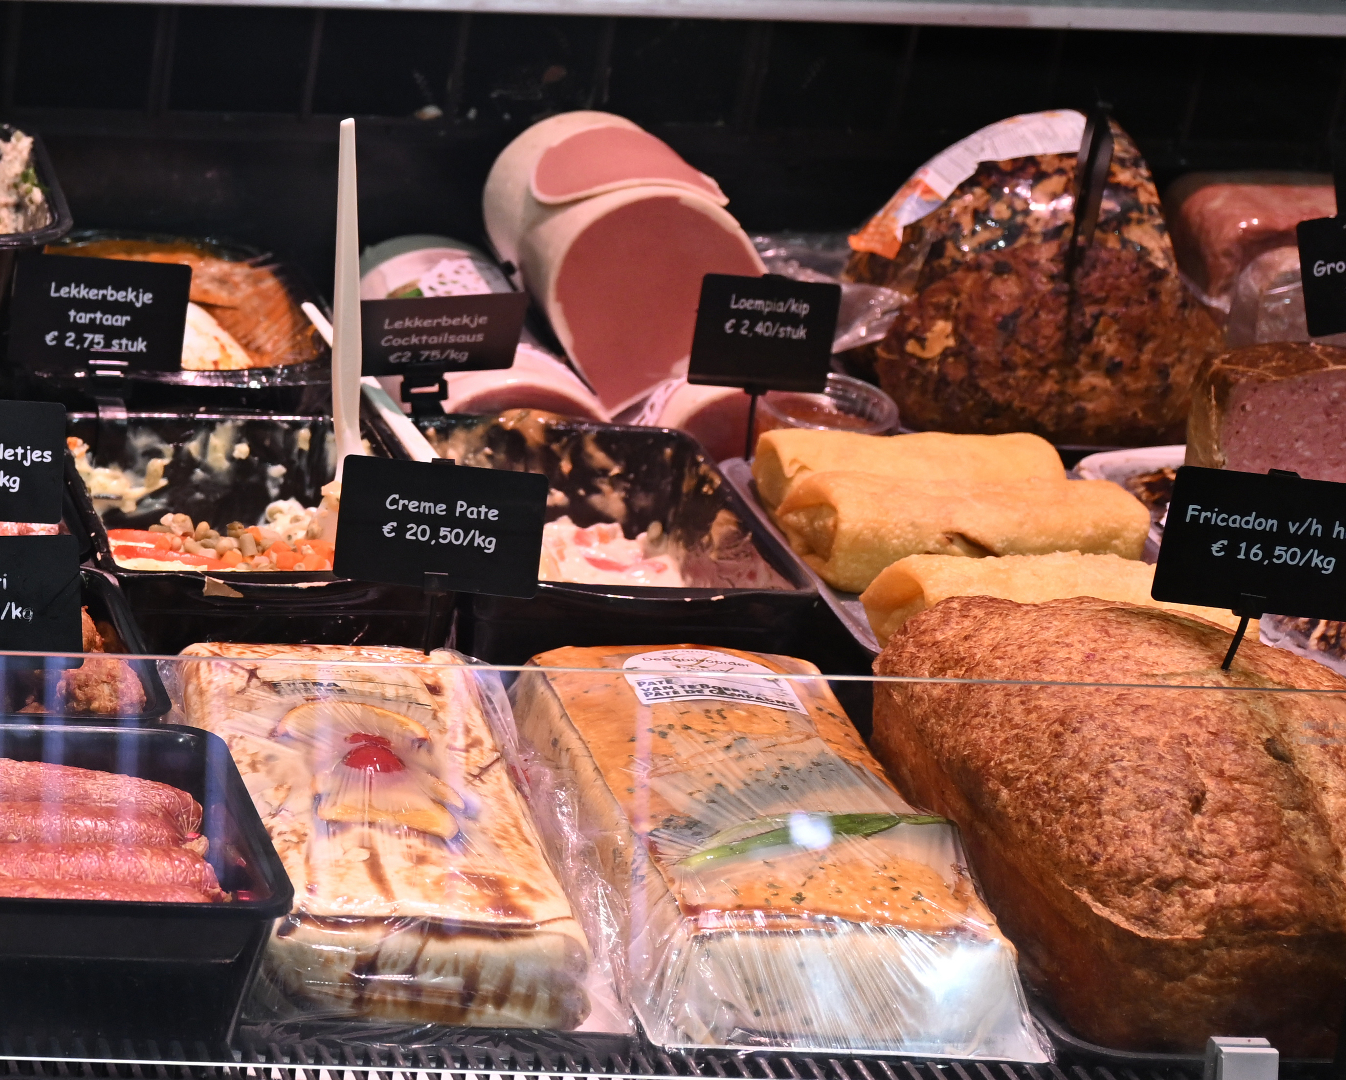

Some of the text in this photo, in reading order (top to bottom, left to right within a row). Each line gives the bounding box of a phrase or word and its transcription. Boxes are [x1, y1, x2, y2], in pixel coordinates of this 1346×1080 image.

[50, 281, 153, 308] Lekkerbekje
[729, 294, 810, 319] Loempia/kip
[68, 308, 131, 327] tartaar
[383, 313, 489, 330] Lekkerbekje
[724, 318, 737, 334] €
[44, 331, 147, 353] € 2,75 stuk
[380, 332, 485, 347] Cocktailsaus
[385, 493, 500, 521] Creme Pate
[1185, 504, 1278, 533] Fricadon
[1288, 517, 1323, 538] v/h
[381, 521, 497, 554] € 20,50/kg
[1210, 539, 1336, 575] € 16,50/kg
